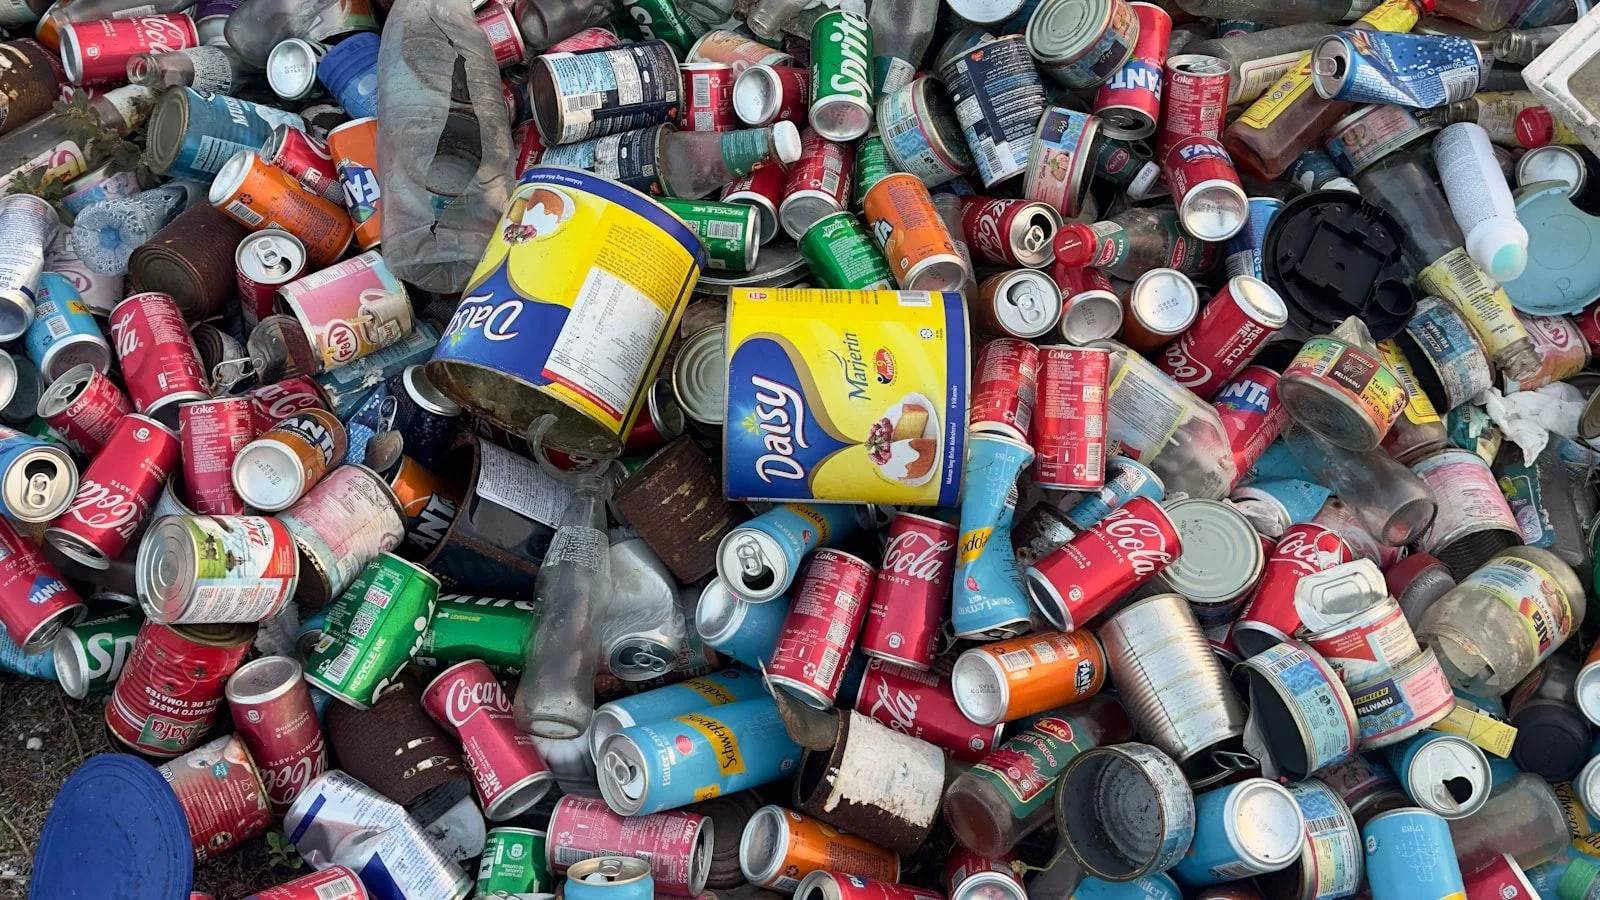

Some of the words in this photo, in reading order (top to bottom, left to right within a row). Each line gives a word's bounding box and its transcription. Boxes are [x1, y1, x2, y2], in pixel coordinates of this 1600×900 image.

[1110, 60, 1162, 98] FANT
[1172, 71, 1194, 84] Coke
[707, 207, 744, 216] RECYCLE
[1048, 349, 1073, 360] Coke
[1223, 326, 1264, 366] RECYCLE
[830, 331, 868, 402] Marjerin
[1334, 370, 1361, 389] FELIVARU
[1372, 378, 1391, 396] Tuna
[66, 397, 89, 418] Coke
[190, 404, 216, 415] Coke
[750, 375, 807, 483] Daisy
[110, 479, 134, 496] TASTE
[815, 551, 838, 562] Coke
[1104, 540, 1124, 563] TASTE
[887, 575, 911, 587] TASTE
[1533, 611, 1549, 651] Alfa
[350, 652, 377, 693] RECYCLE
[374, 636, 387, 655] ME
[145, 686, 188, 709] TOMATES
[1358, 698, 1393, 714] FELIVARU
[148, 698, 180, 717] PASTE
[182, 705, 216, 717] TOMATO
[151, 719, 193, 746] Safa
[1038, 719, 1069, 738] KING
[268, 754, 296, 767] TASTE
[684, 819, 697, 845] Coke
